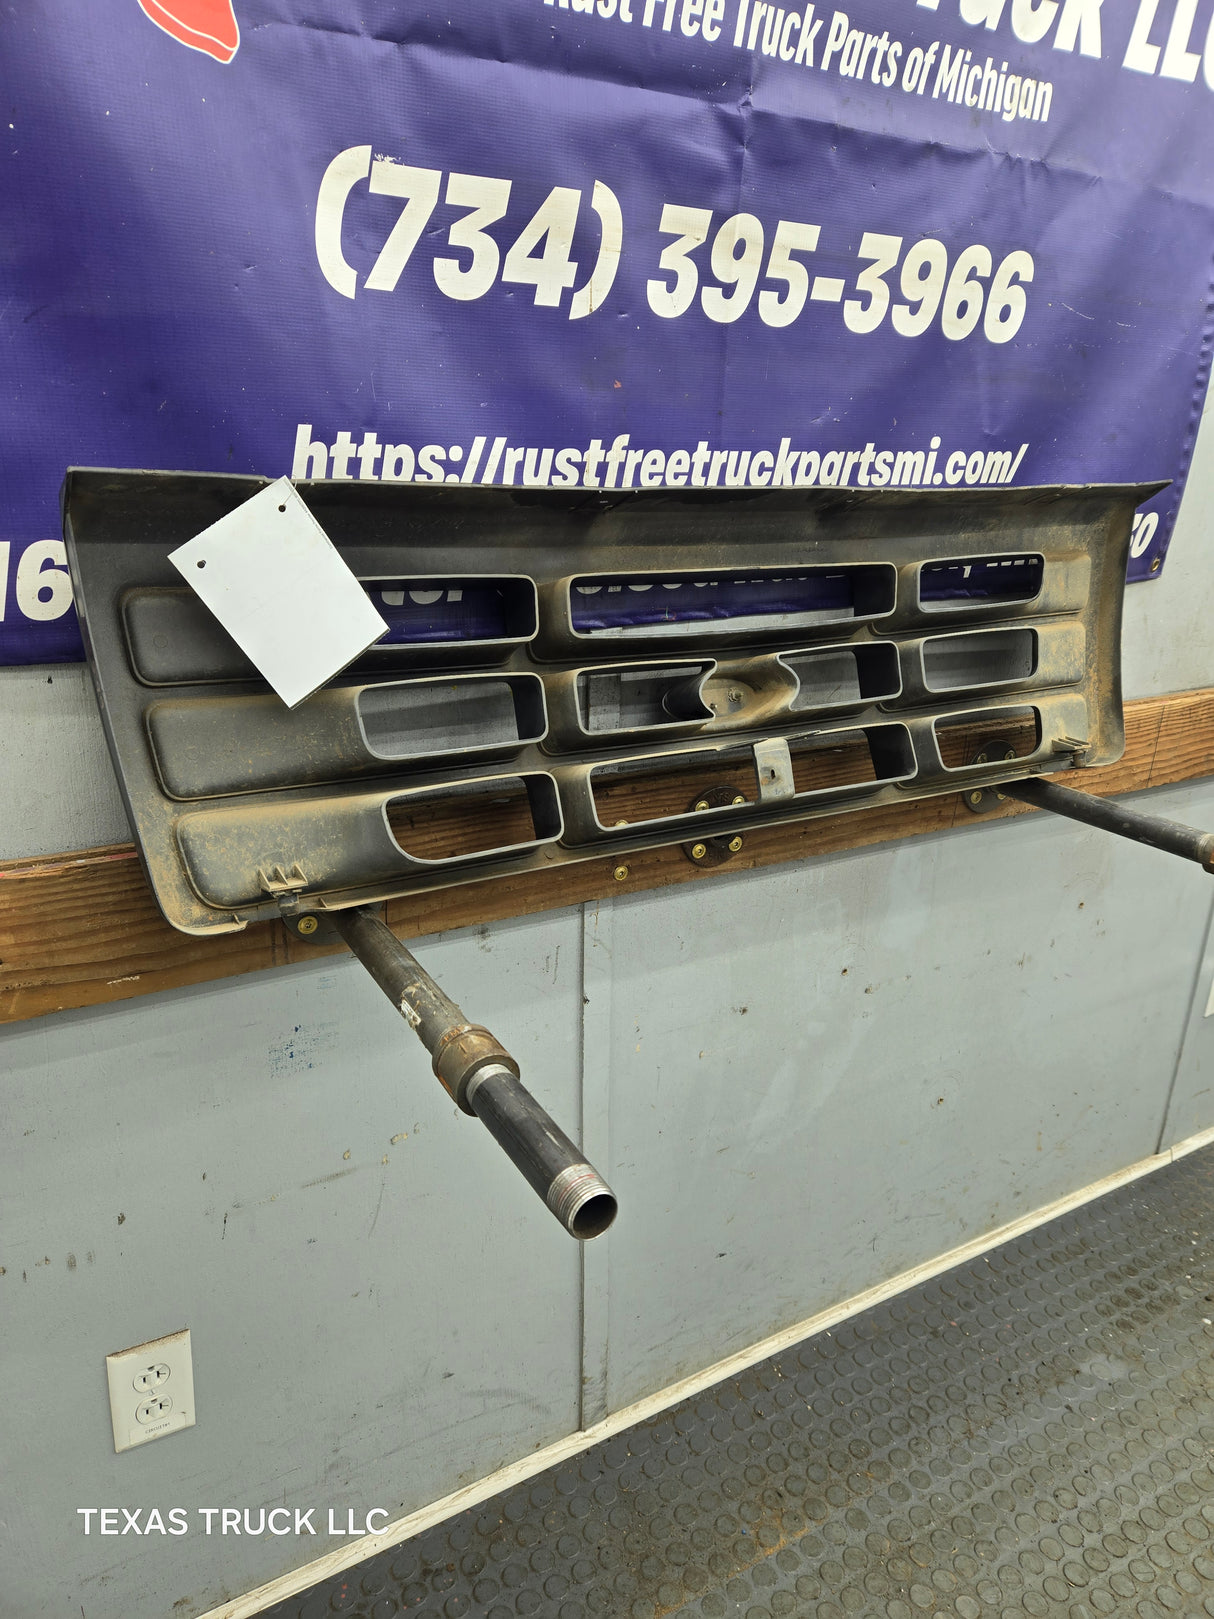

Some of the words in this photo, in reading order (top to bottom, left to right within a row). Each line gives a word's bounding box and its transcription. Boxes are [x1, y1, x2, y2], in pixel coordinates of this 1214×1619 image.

[733, 0, 824, 67] Truck
[821, 11, 902, 88] Parts
[902, 42, 940, 96] of
[932, 44, 1053, 123] Michigan
[315, 144, 623, 320] (734)
[646, 203, 1034, 344] 395-3966
[0, 539, 74, 622] 6
